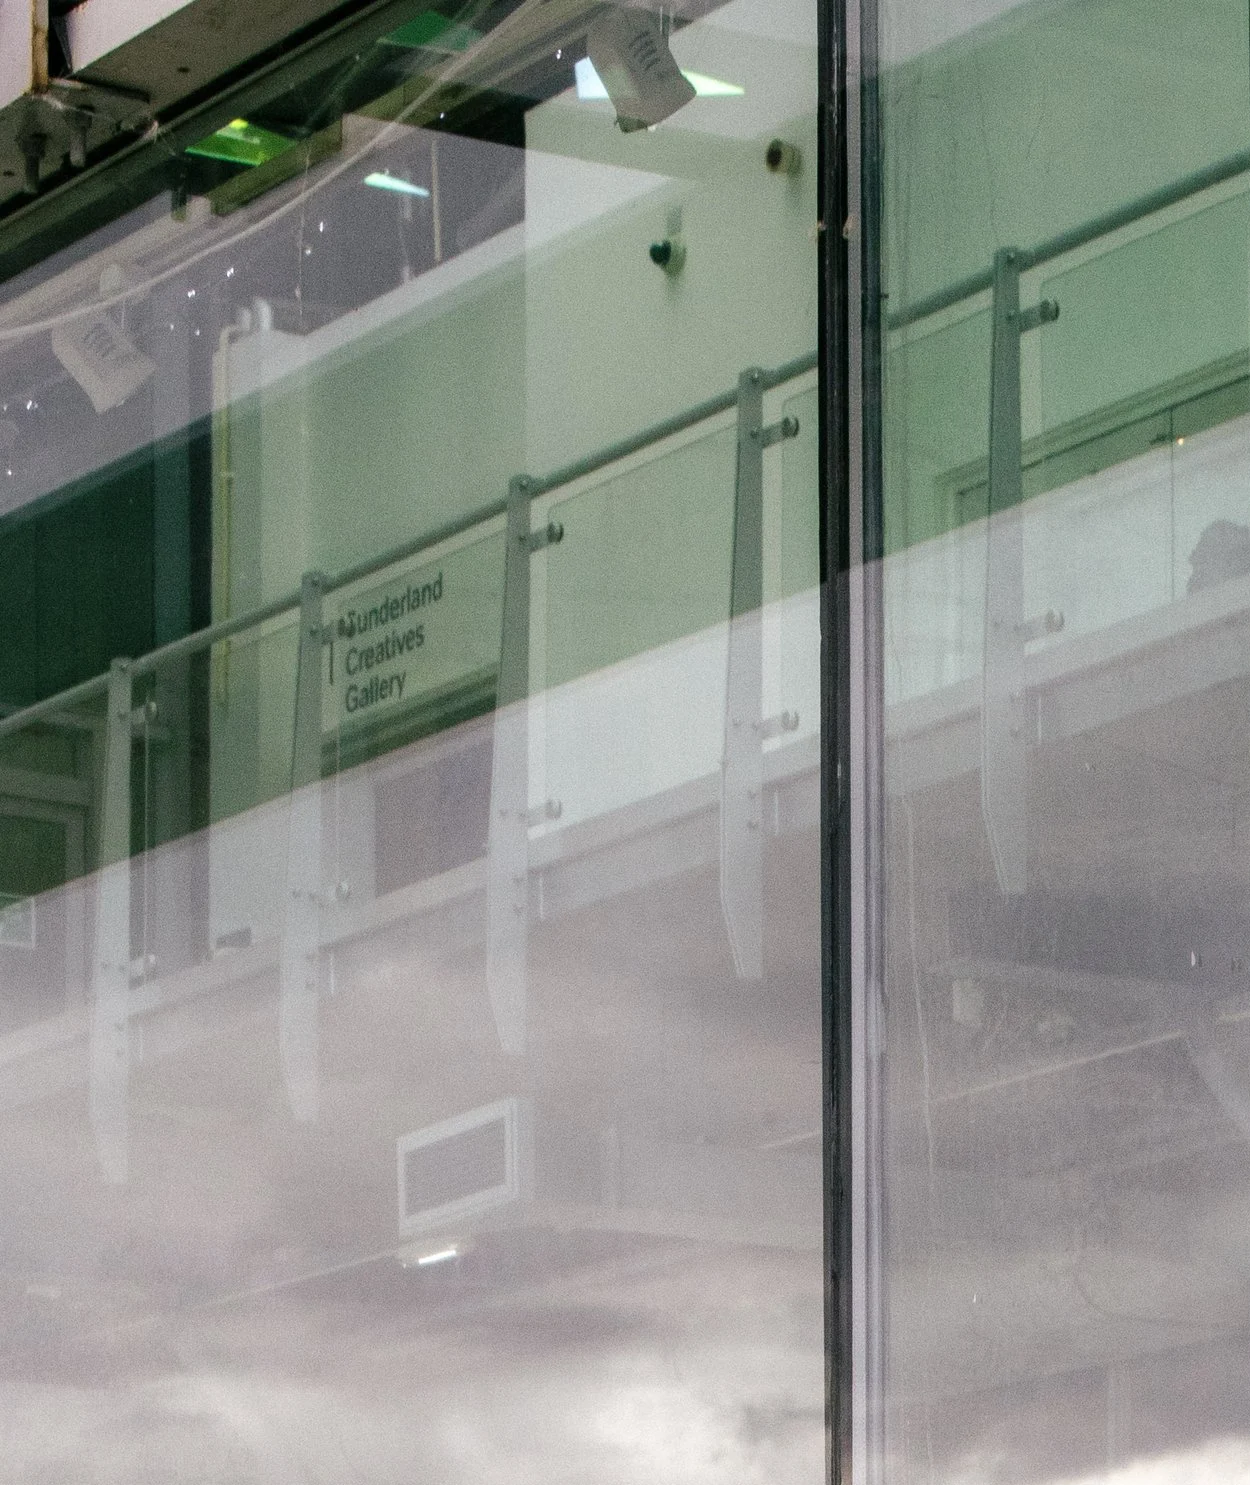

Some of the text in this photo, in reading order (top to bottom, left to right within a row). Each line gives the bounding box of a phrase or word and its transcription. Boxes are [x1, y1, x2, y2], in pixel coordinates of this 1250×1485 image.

[346, 572, 443, 637] Sunderland
[346, 624, 425, 675] Creatives
[346, 671, 407, 712] Gallery
